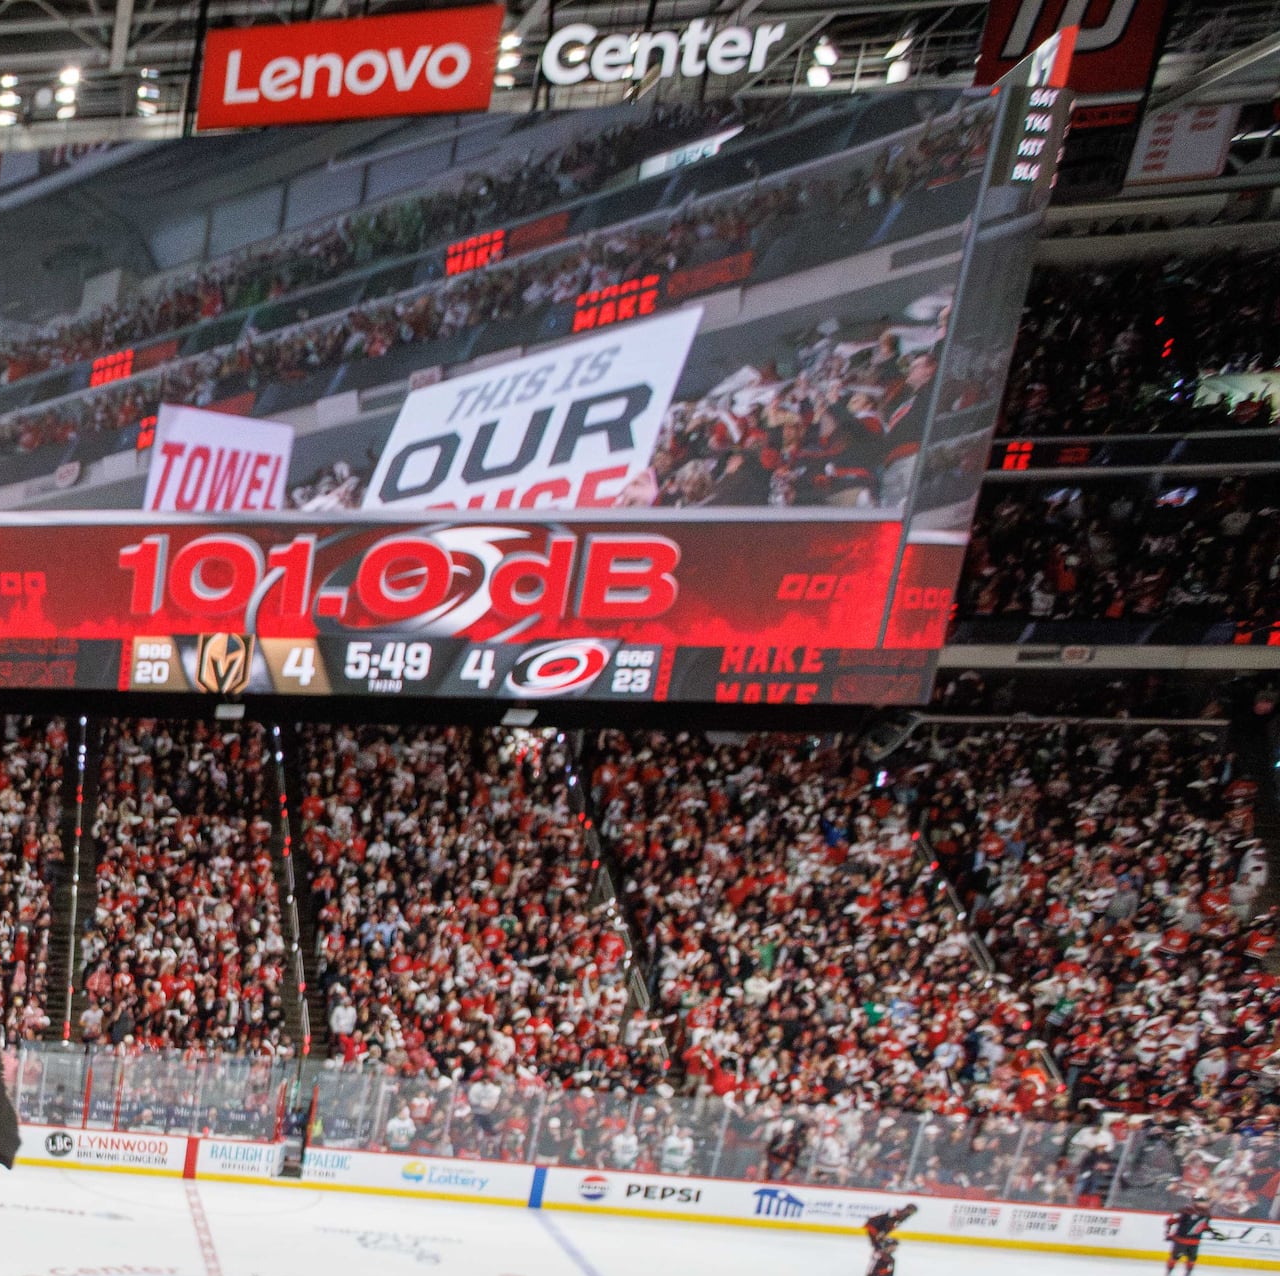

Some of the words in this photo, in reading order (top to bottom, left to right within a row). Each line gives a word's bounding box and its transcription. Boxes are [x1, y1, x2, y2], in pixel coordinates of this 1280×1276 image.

[223, 42, 470, 104] Lenovo
[541, 21, 786, 86] Center
[572, 289, 658, 334] MAKE
[445, 361, 548, 425] THIS
[560, 345, 623, 391] IS
[378, 384, 653, 503] OUR
[152, 442, 283, 511] TOWEL
[488, 532, 682, 622] dB
[282, 647, 316, 686] 4
[344, 641, 432, 682] 5:49
[460, 649, 496, 690] 4
[720, 645, 825, 675] MAKE
[134, 661, 170, 685] 20
[611, 668, 652, 693] 23
[367, 678, 404, 694] THIRD
[48, 1135, 73, 1151] LBC
[77, 1134, 169, 1156] LYNNWOOD
[210, 1142, 263, 1162] RALEIGH
[428, 1166, 489, 1191] Lottery
[625, 1183, 702, 1203] PEPSI
[953, 1203, 990, 1216] STORM
[966, 1215, 999, 1227] BREW
[1012, 1208, 1048, 1221] STORM
[1072, 1213, 1109, 1226] STORM
[1024, 1220, 1058, 1233] BREW
[1085, 1225, 1121, 1238] BREW
[49, 1264, 182, 1276] Center
